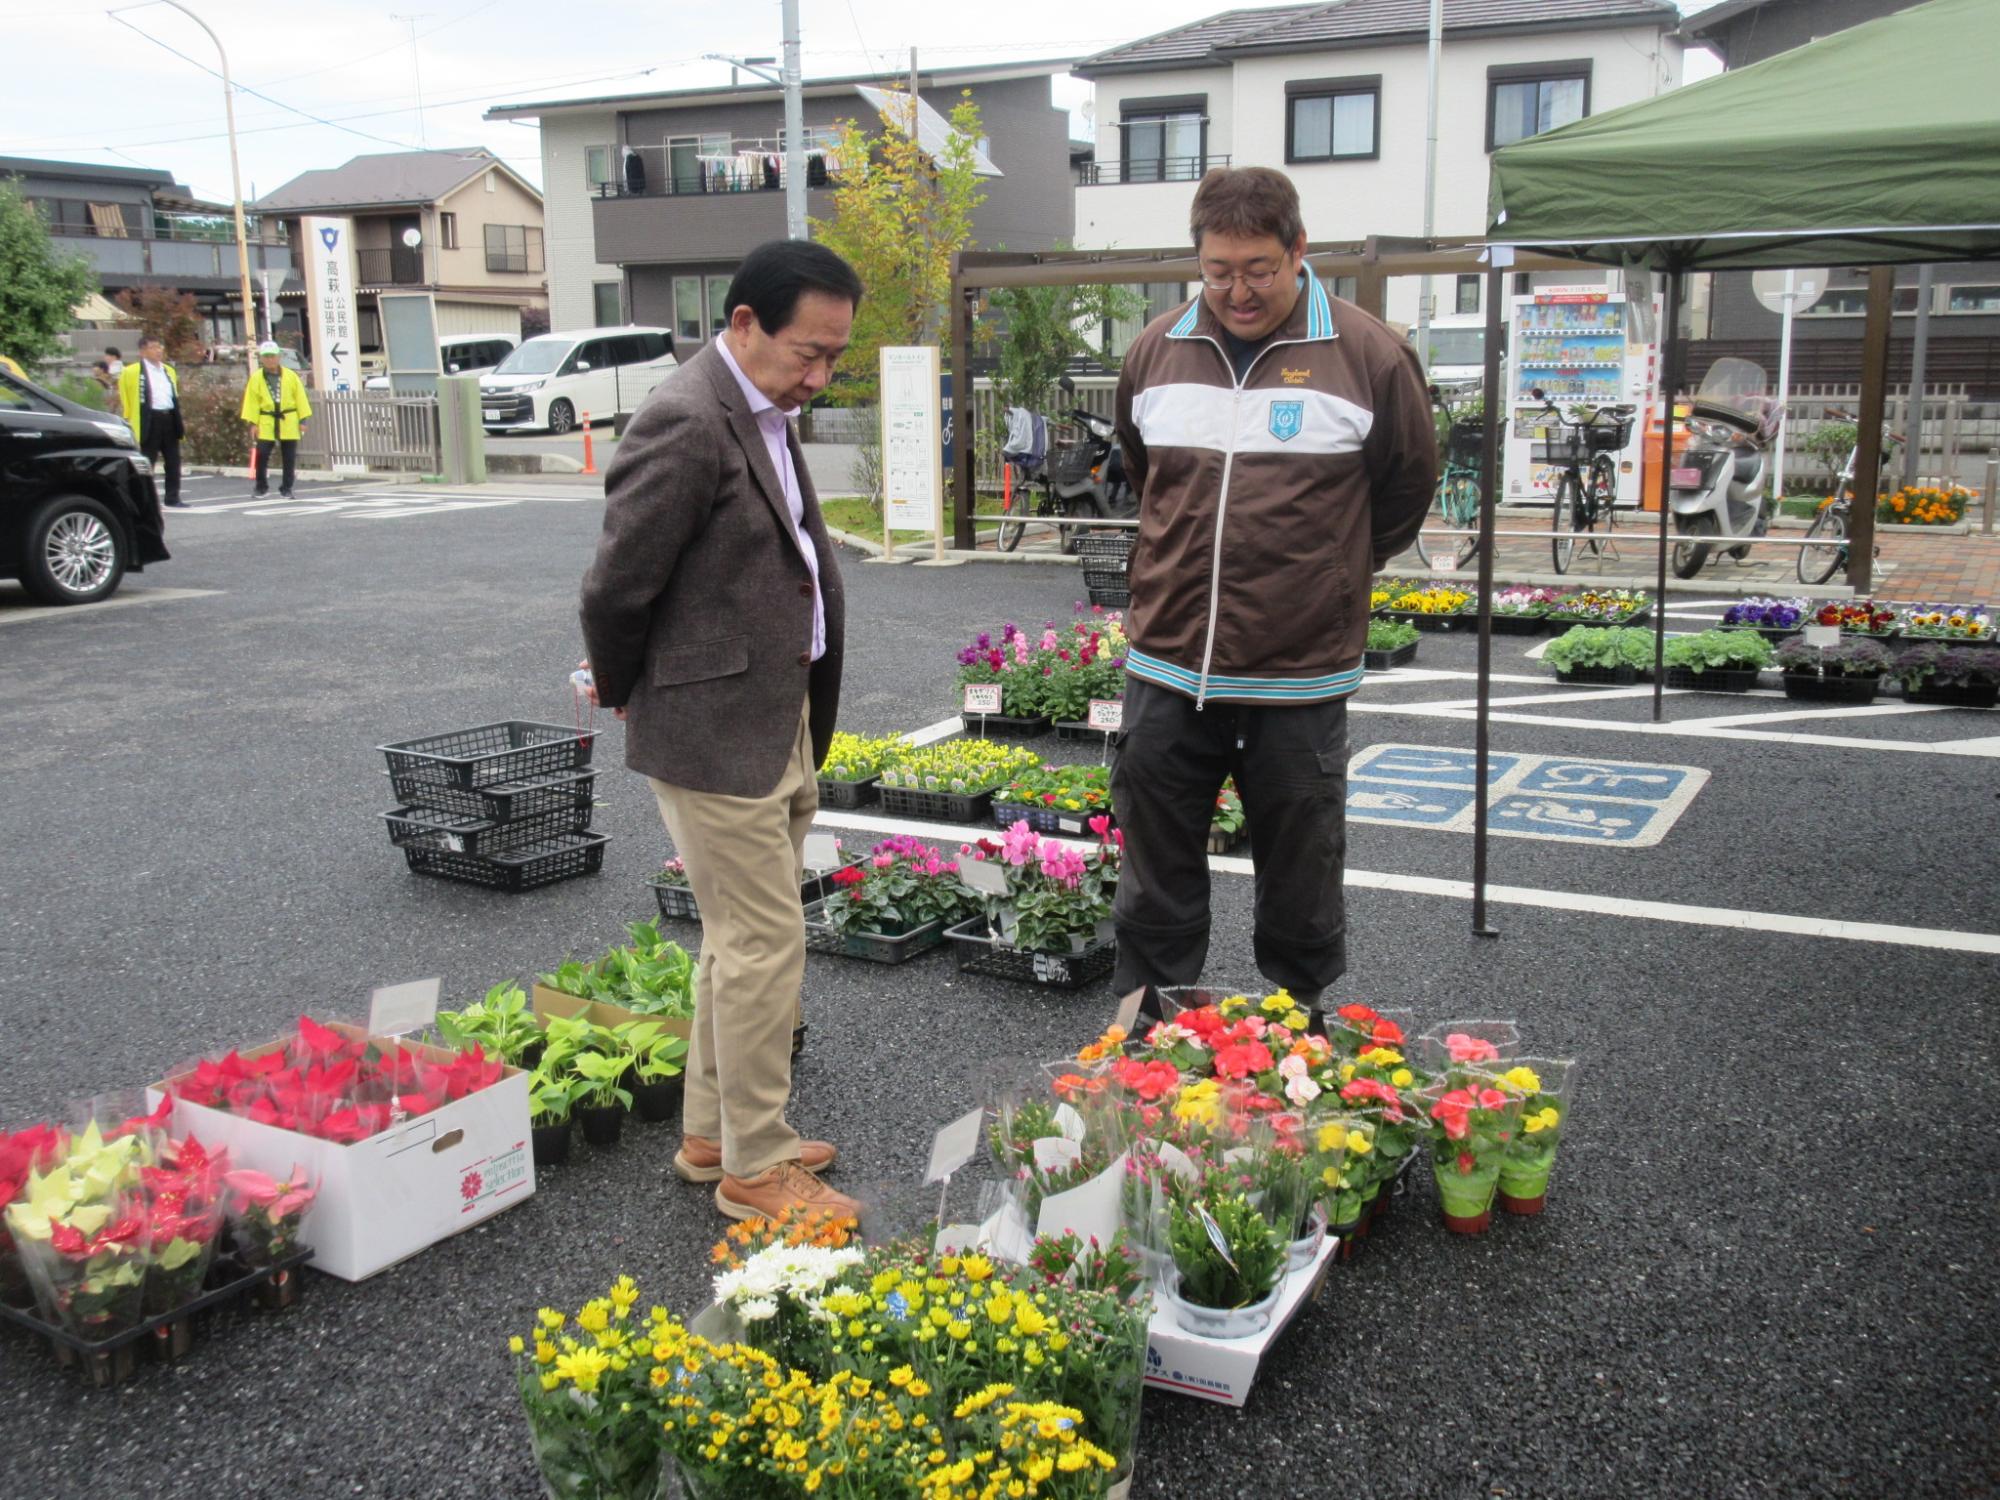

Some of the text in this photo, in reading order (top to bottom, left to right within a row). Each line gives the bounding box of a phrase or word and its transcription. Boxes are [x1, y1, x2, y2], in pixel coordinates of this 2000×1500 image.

[327, 261, 340, 293] 高萩
[324, 297, 336, 338] 出張所
[336, 297, 348, 338] 公民館
[331, 368, 340, 381] P
